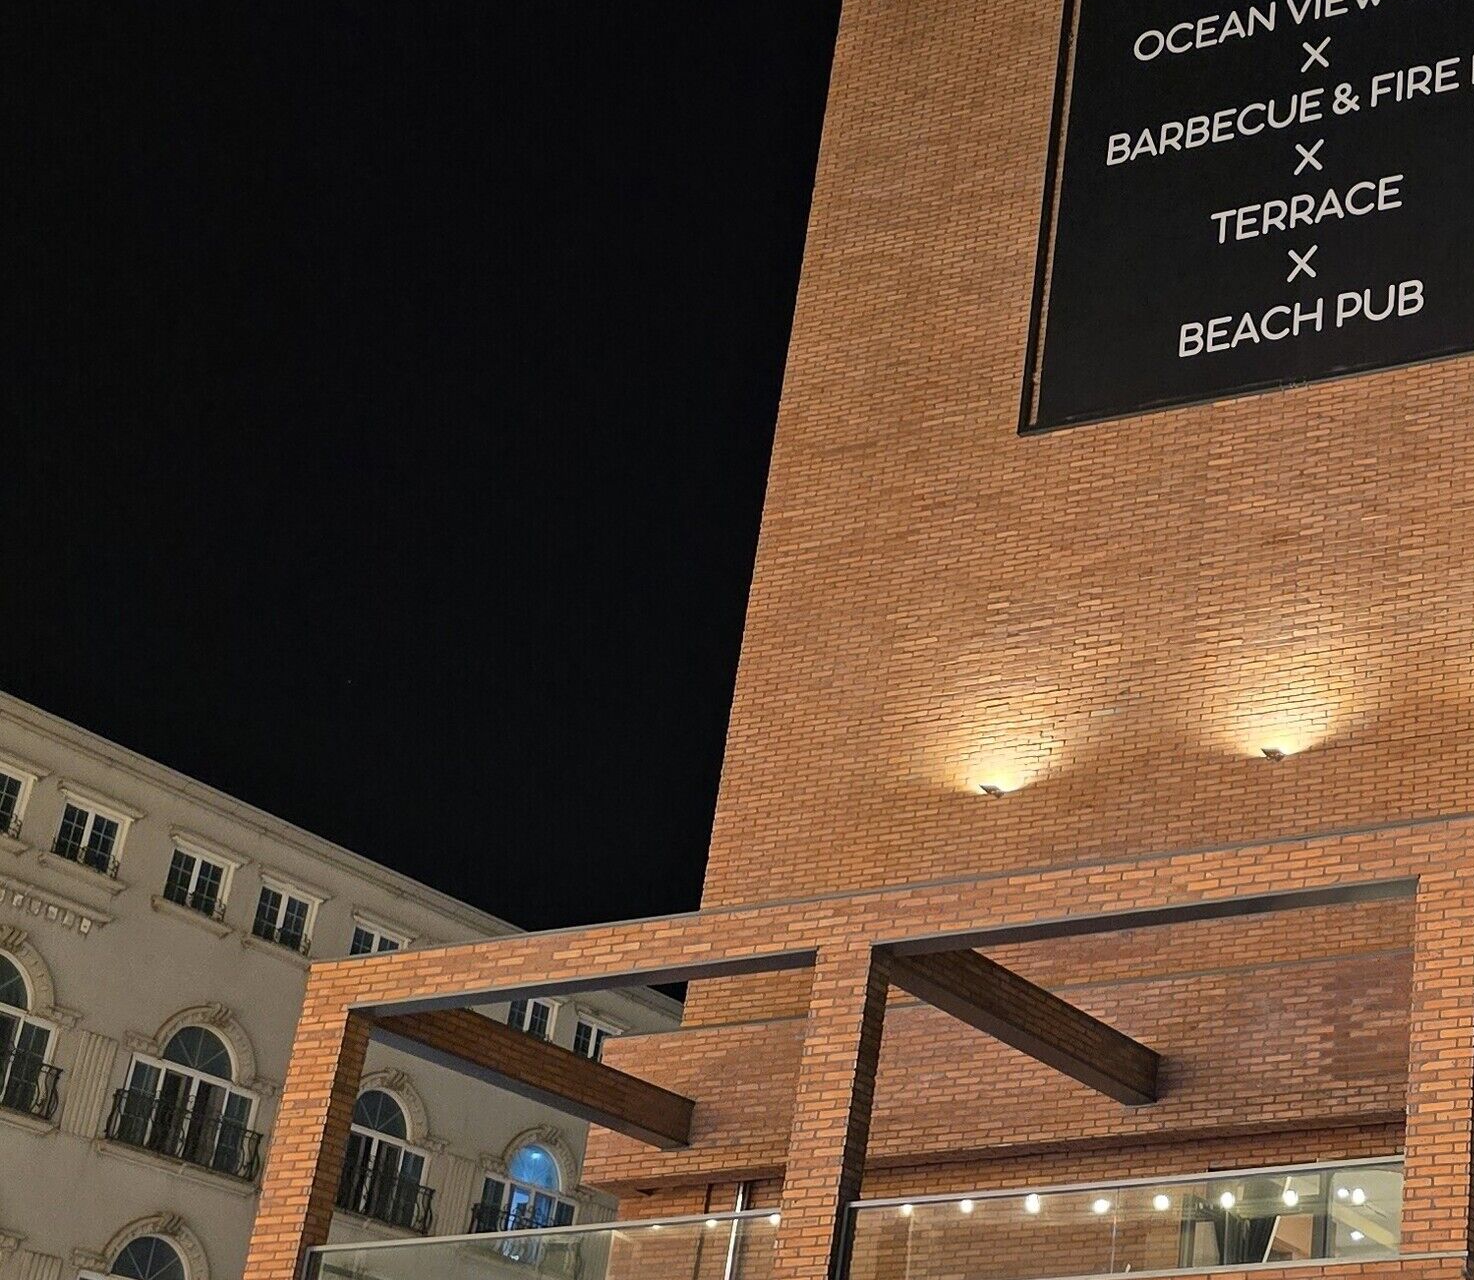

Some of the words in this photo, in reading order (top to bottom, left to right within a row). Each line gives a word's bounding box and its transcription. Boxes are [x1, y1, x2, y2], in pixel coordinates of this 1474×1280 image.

[1133, 1, 1277, 61] OCEAN
[1106, 87, 1324, 166] BARBECUE
[1333, 82, 1361, 115] &
[1371, 56, 1461, 107] FIRE
[1211, 174, 1404, 244] TERRACE
[1178, 298, 1323, 358] BEACH
[1336, 280, 1425, 329] PUB
